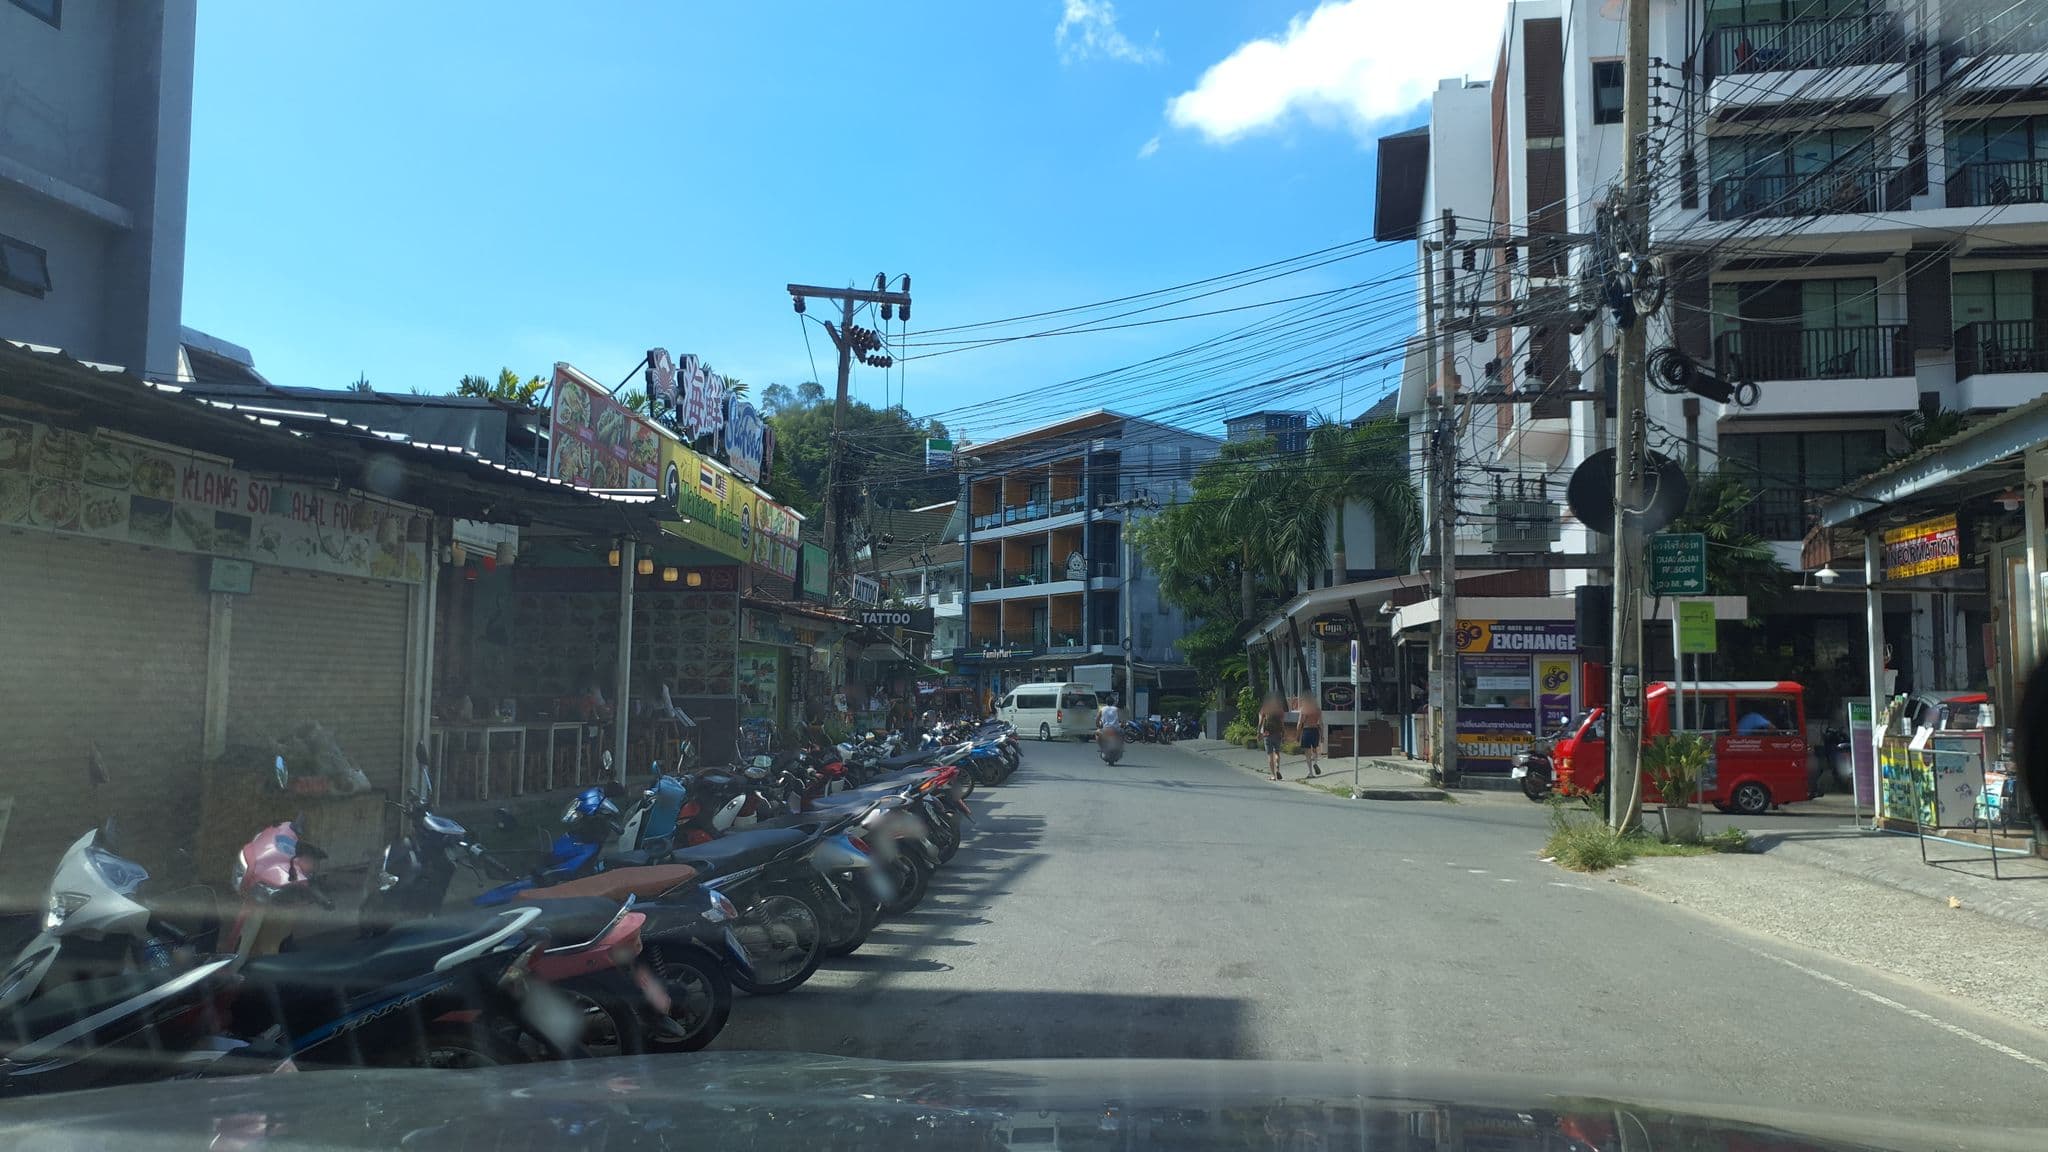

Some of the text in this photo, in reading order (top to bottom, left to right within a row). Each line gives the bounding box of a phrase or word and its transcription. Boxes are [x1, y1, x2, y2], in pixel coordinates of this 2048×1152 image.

[181, 466, 239, 507] KLANG
[1887, 535, 1957, 566] INFORMATION
[861, 612, 911, 624] TATTOO
[1492, 633, 1577, 650] EXCHANGE
[982, 648, 1012, 660] FamilyMart
